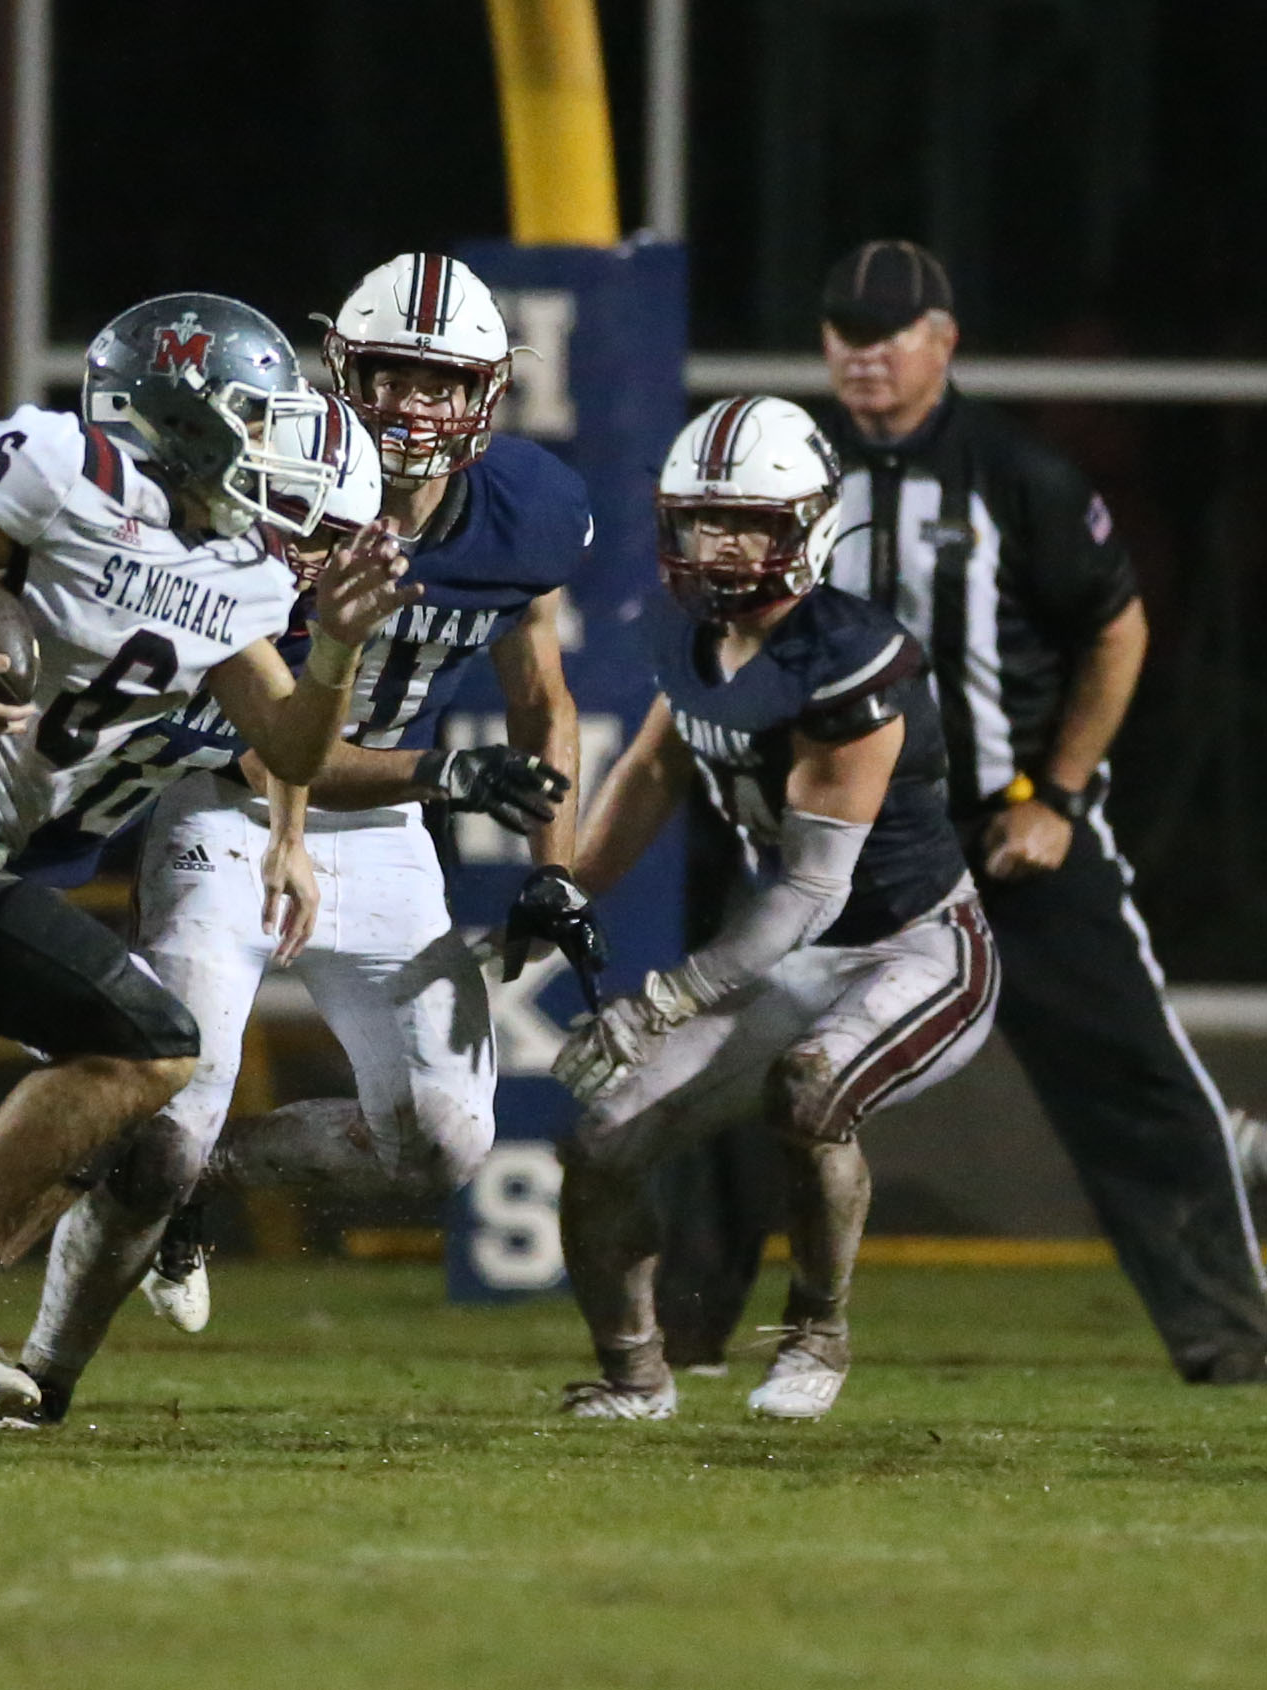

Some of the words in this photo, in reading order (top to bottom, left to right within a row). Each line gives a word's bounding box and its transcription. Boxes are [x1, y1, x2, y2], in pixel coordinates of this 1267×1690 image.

[415, 336, 433, 349] 42
[94, 553, 239, 646] ST.MICHAEL
[380, 604, 500, 647] NNAN
[174, 861, 216, 873] adidas
